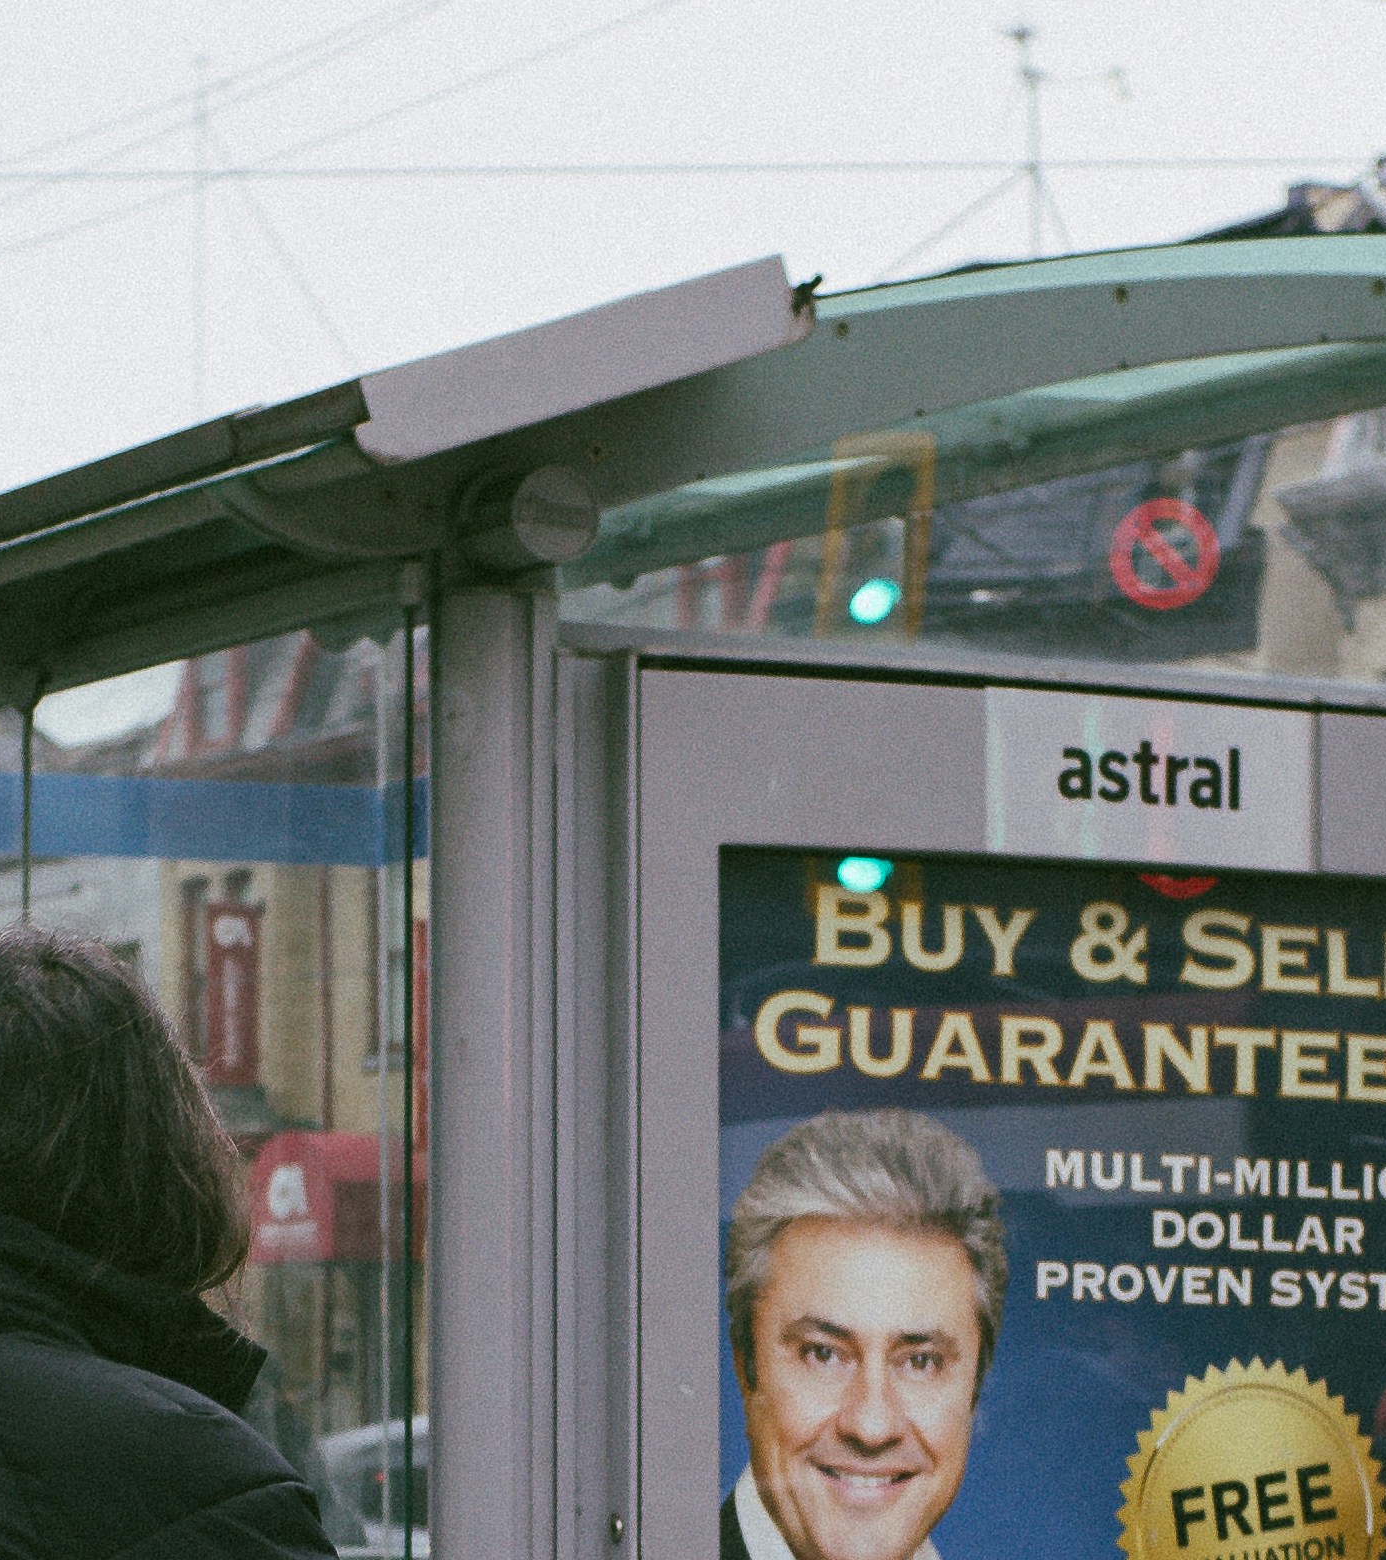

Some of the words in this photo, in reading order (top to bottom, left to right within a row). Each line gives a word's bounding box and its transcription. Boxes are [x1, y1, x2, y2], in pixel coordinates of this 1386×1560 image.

[1058, 739, 1241, 811] astral
[1069, 901, 1150, 985] &
[1151, 1209, 1365, 1255] DOLLAR
[1036, 1261, 1253, 1307] PROVEN
[1171, 1461, 1338, 1549] FREE
